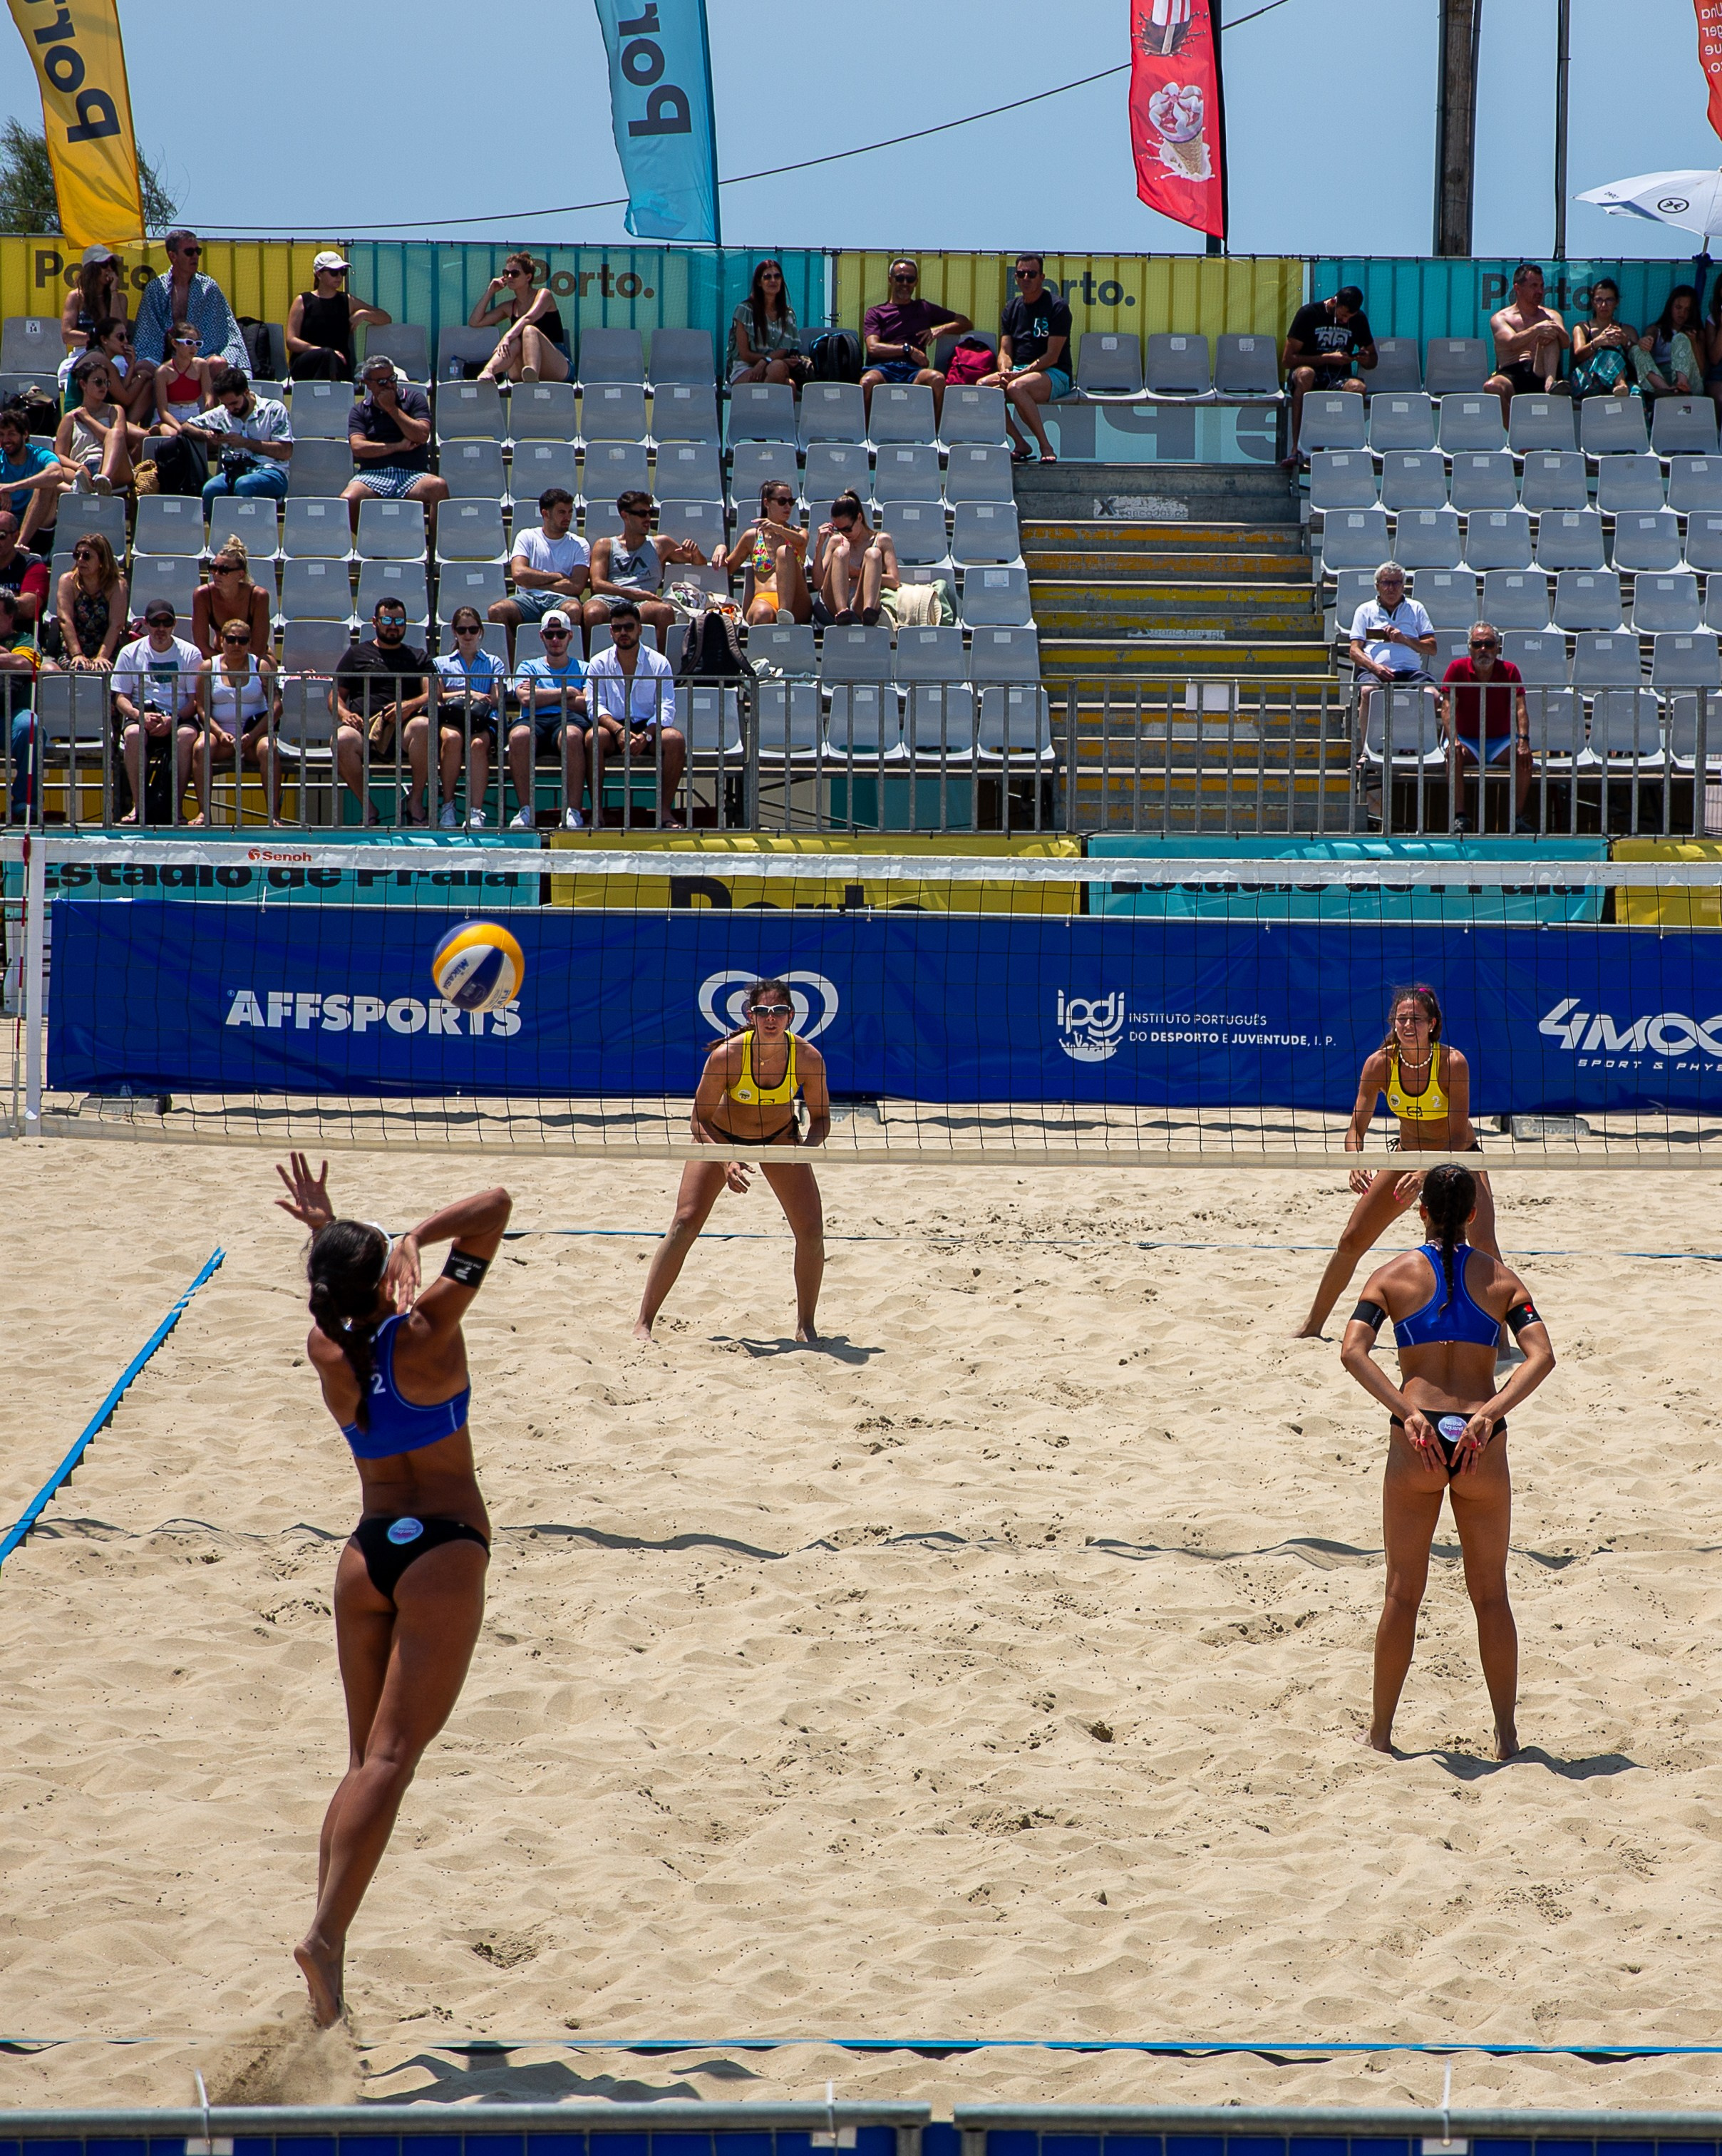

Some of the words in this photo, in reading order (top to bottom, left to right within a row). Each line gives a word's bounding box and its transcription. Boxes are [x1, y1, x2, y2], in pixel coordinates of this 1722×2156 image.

[262, 850, 312, 862] Senoh
[1128, 1012, 1191, 1025] INSTITUTO
[1194, 1012, 1267, 1026] PORTUGUÊS
[1129, 1031, 1148, 1042] DO
[1150, 1032, 1219, 1043] DESPORTO
[1222, 1033, 1228, 1043] E
[1232, 1033, 1311, 1047] JUVENTUDE,
[1577, 1058, 1642, 1069] SPORT
[1653, 1061, 1664, 1070] &
[1431, 1095, 1442, 1108] 2
[371, 1373, 386, 1394] 2
